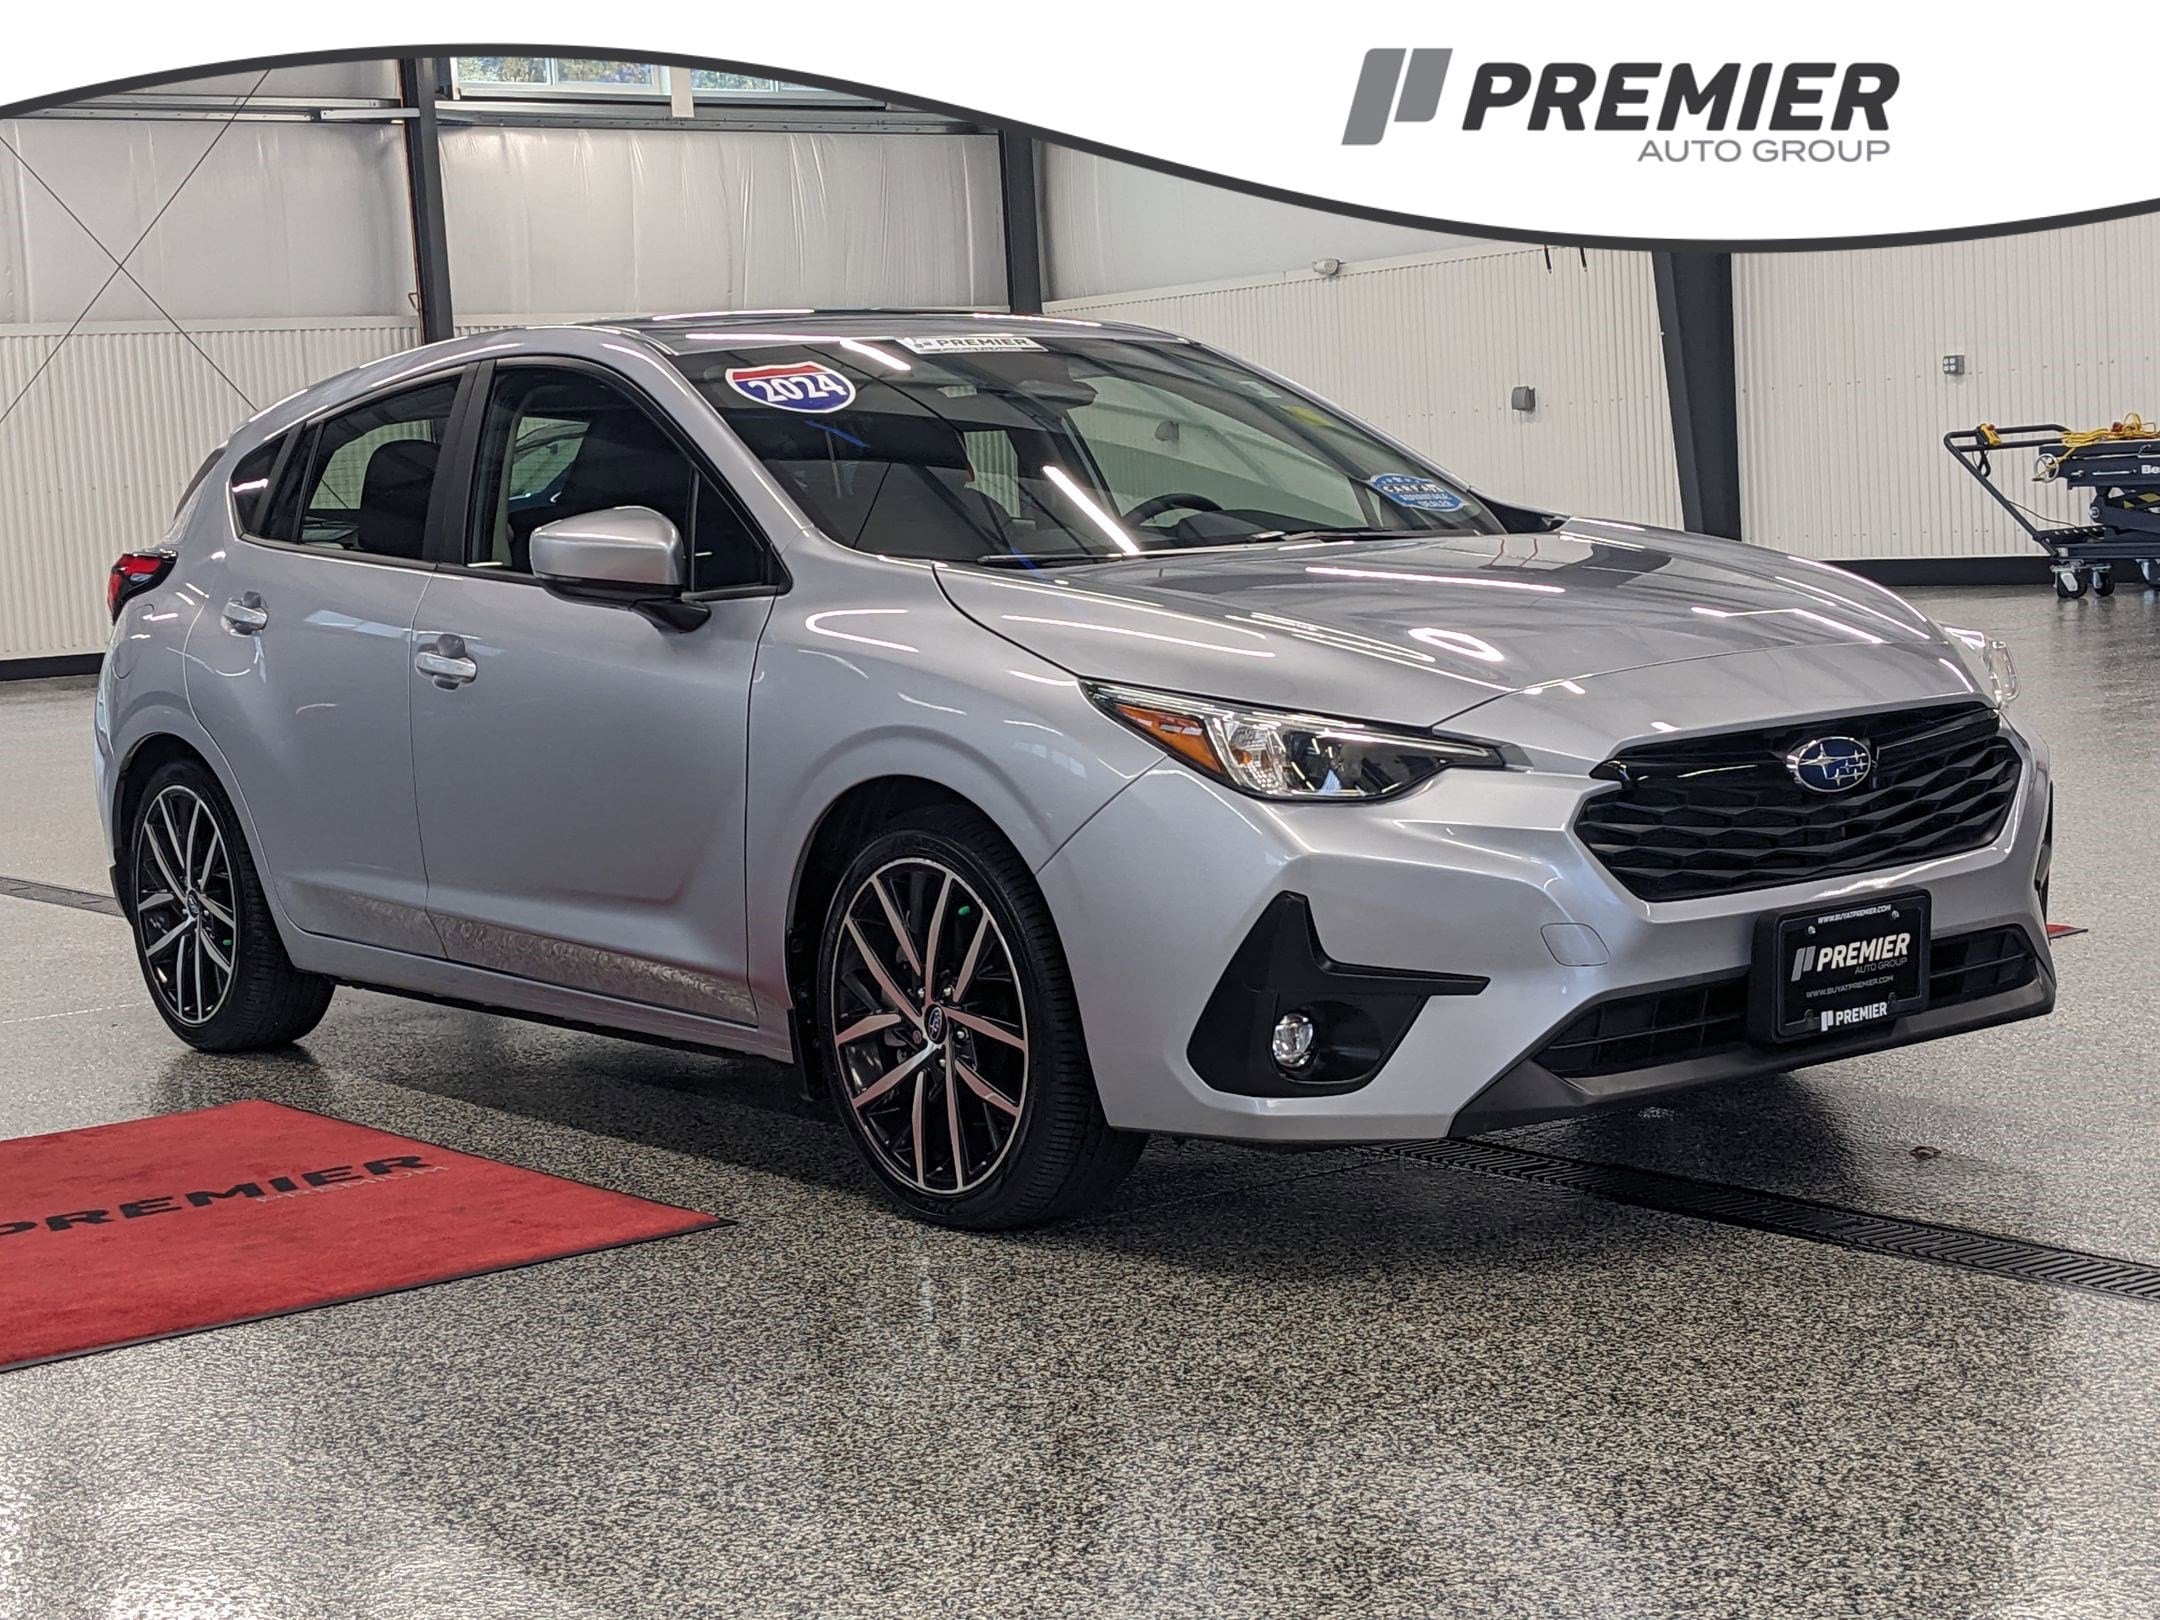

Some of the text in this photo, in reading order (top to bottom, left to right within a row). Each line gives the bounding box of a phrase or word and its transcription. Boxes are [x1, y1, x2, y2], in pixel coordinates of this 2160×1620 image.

[935, 338, 1028, 347] PREMIER
[749, 376, 847, 404] 2024
[1817, 933, 1910, 971] PREMIER
[1855, 957, 1908, 974] AUTO GROUP
[1806, 976, 1893, 997] WWW.BUYATPREMIER.COM
[1836, 1002, 1887, 1025] PREMIER
